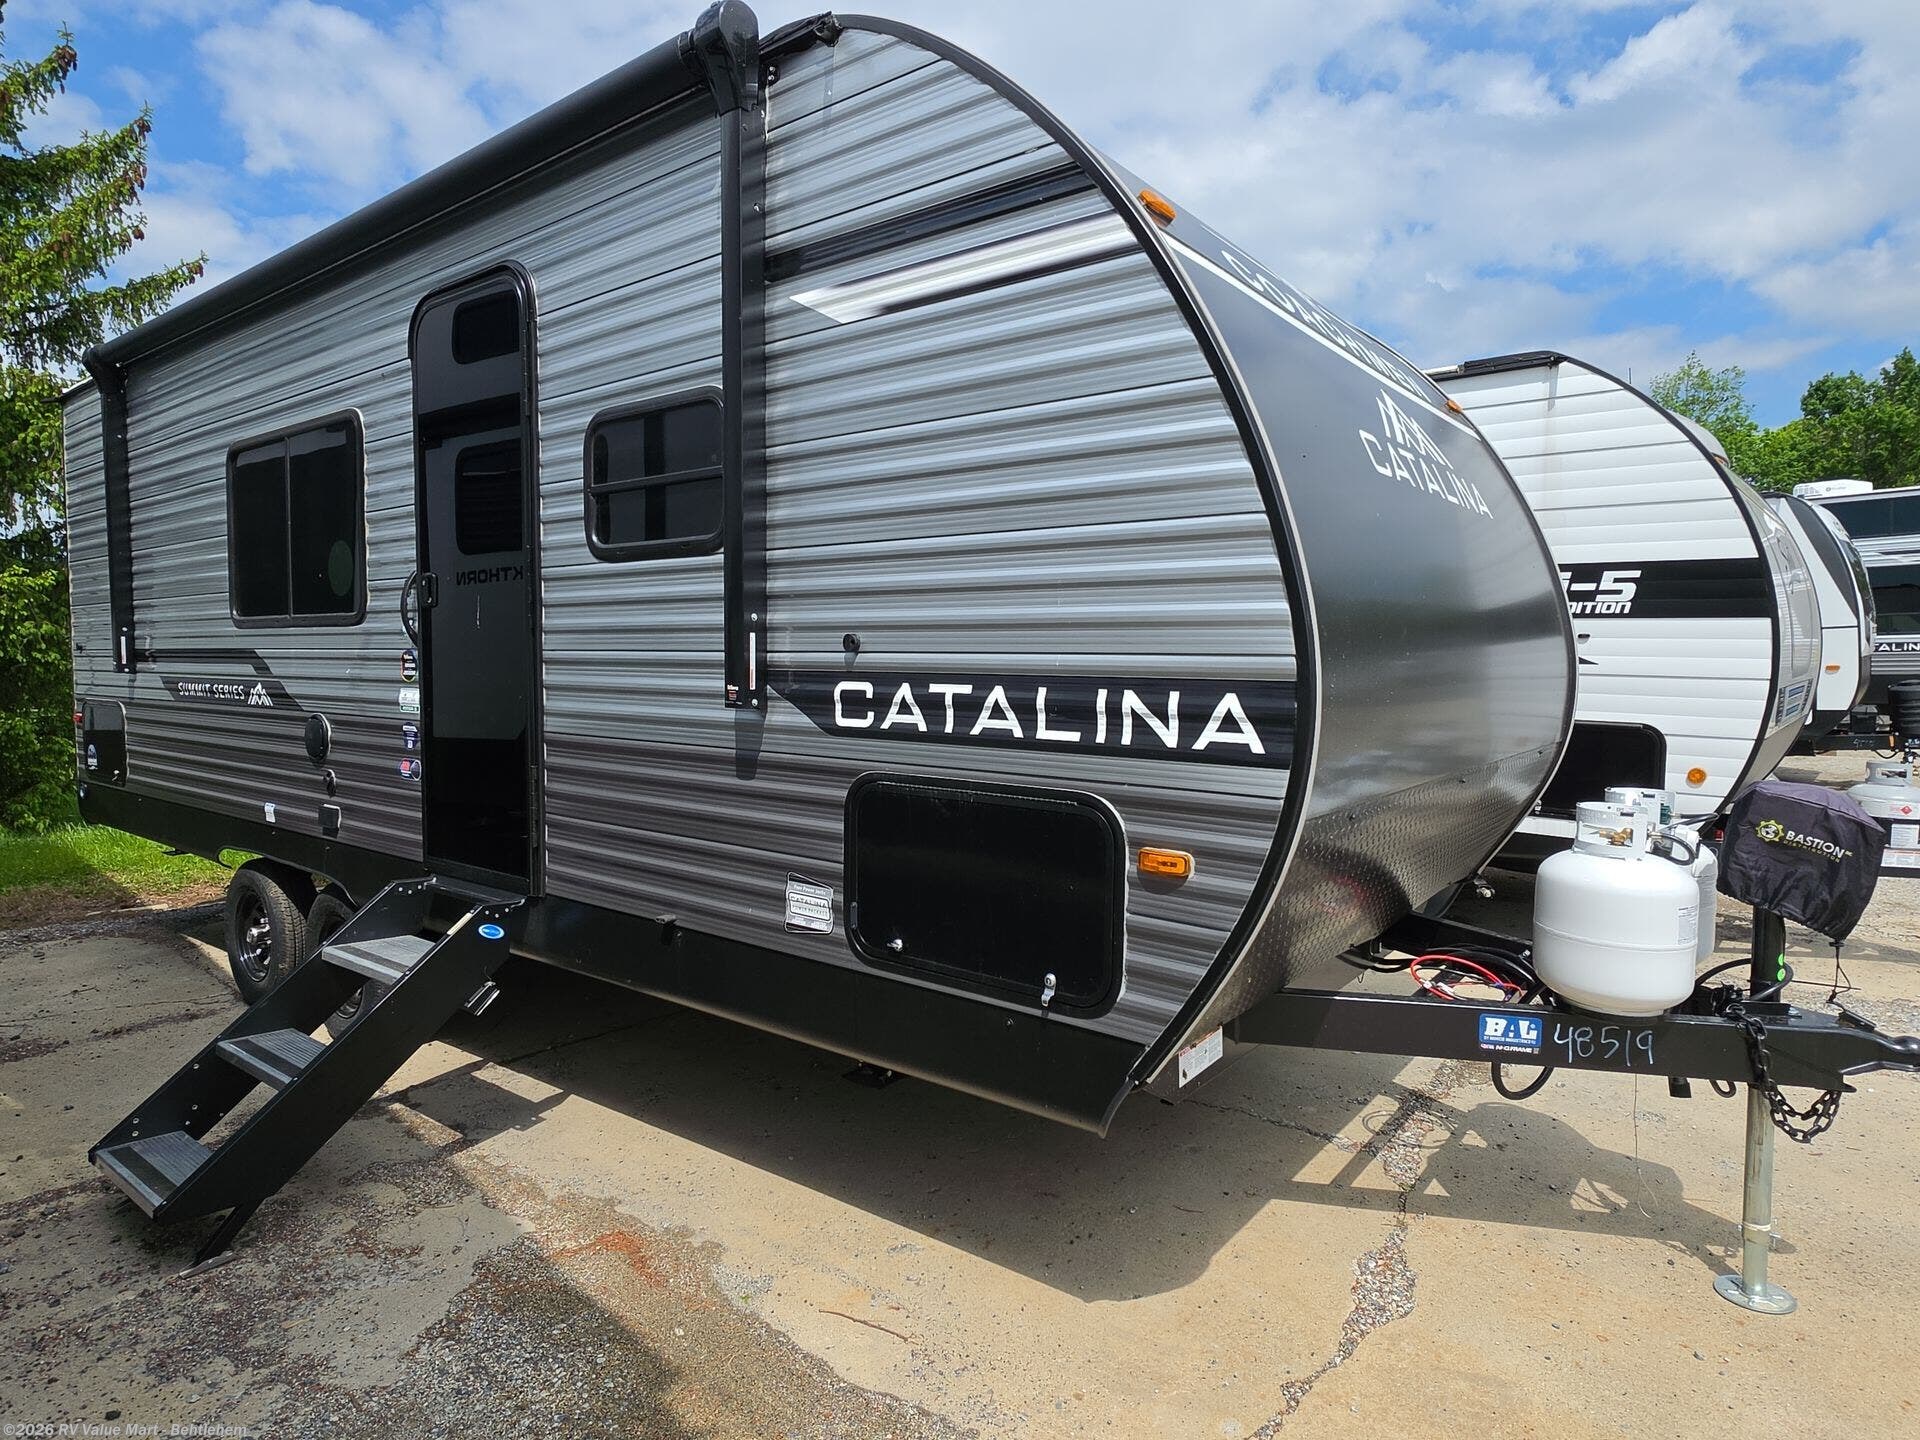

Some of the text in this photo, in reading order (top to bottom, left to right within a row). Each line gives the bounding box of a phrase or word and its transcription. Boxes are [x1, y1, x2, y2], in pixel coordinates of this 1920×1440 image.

[1359, 429, 1493, 519] CATALINA
[178, 682, 245, 700] SUMMIT SERIES
[833, 681, 1266, 754] CATALINA
[1785, 830, 1845, 858] BASTION
[1484, 1017, 1538, 1040] BAL
[1553, 1023, 1654, 1067] 48519
